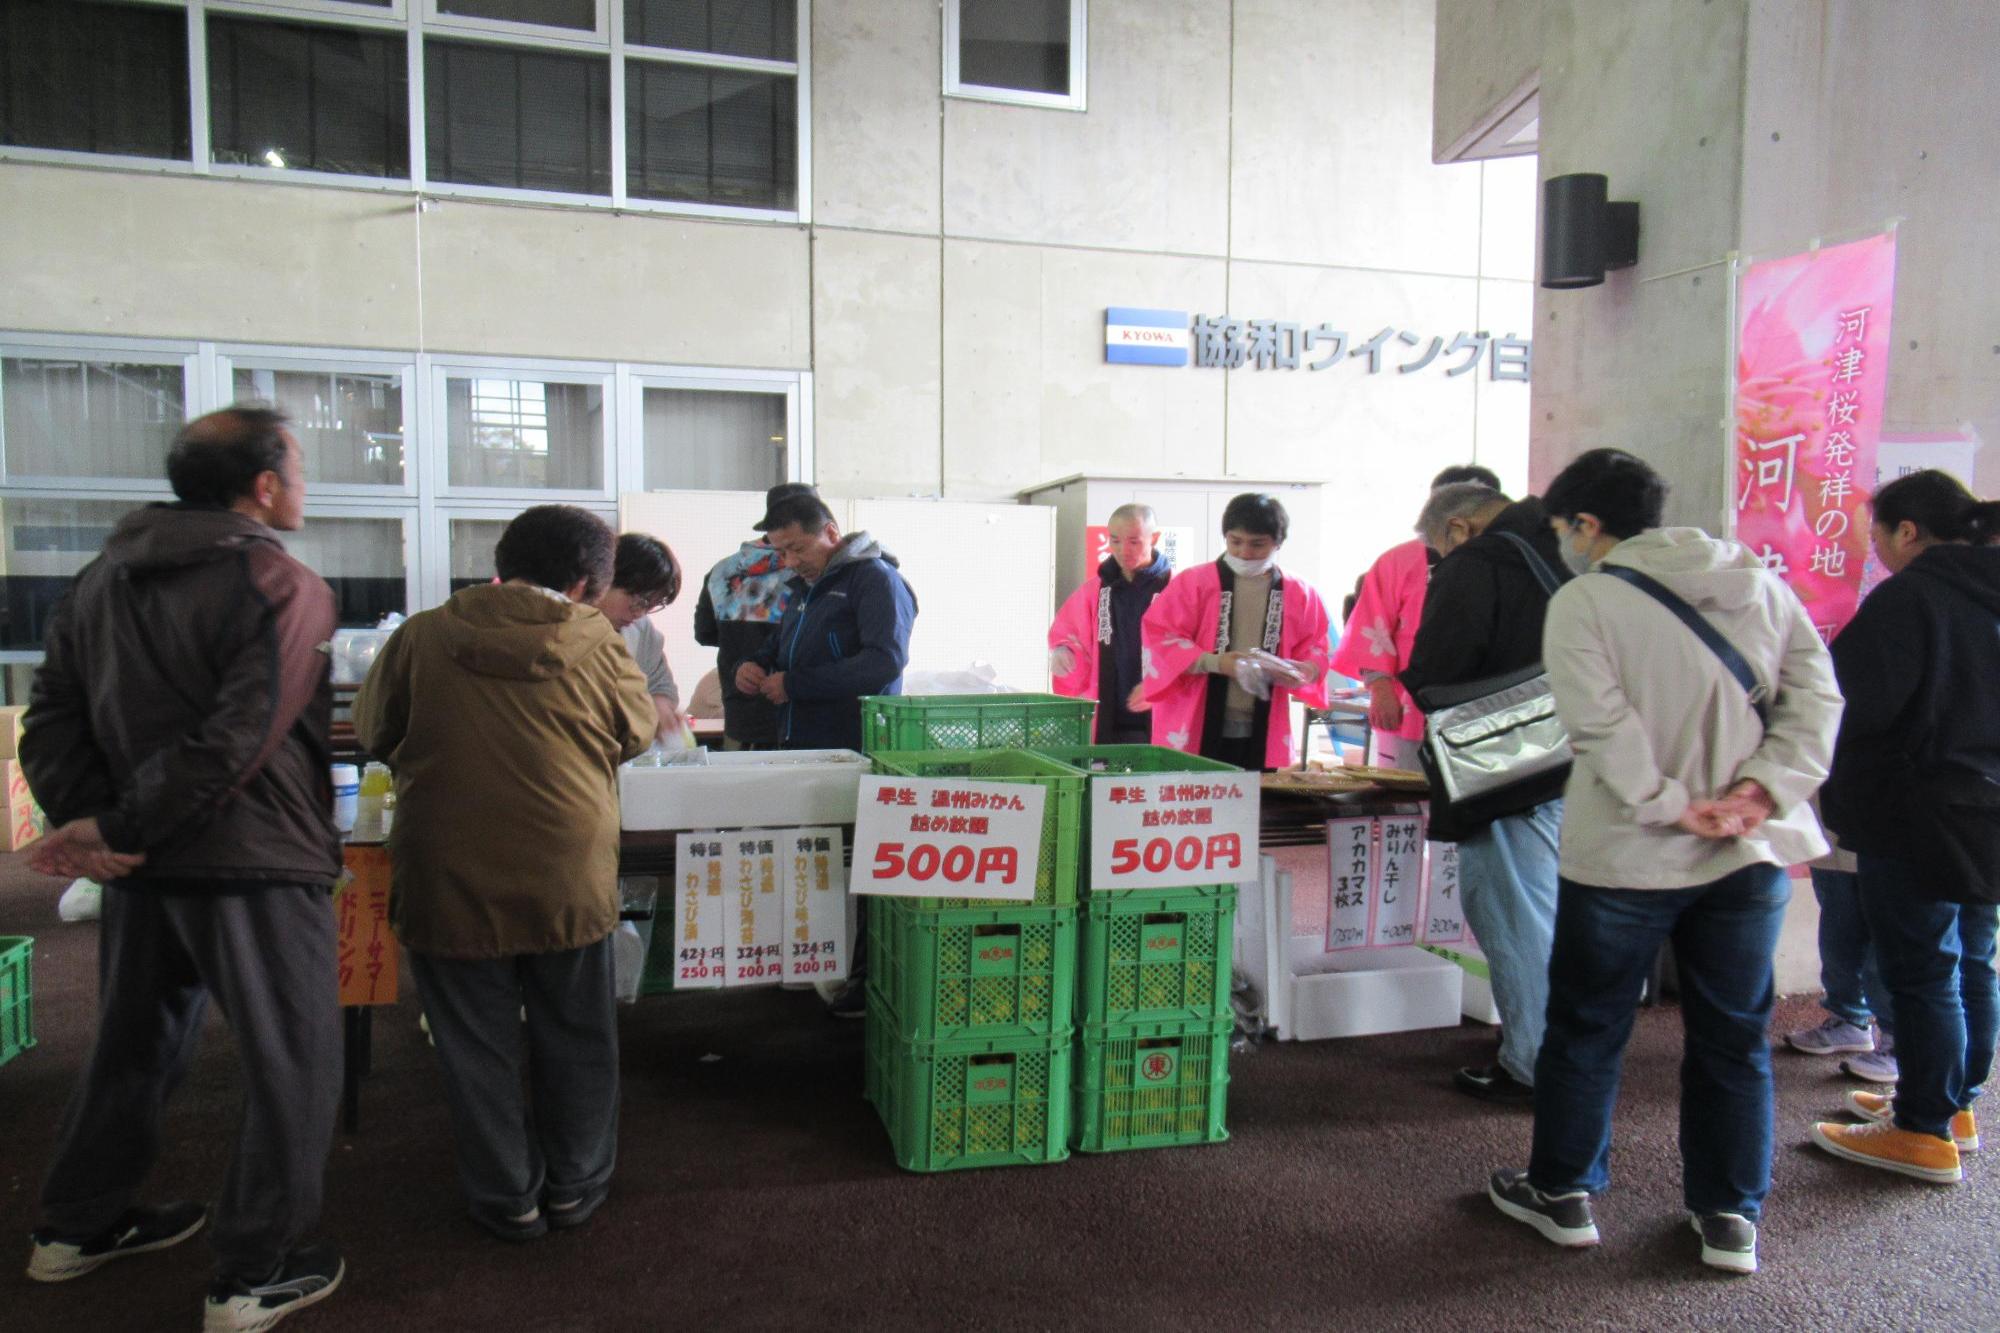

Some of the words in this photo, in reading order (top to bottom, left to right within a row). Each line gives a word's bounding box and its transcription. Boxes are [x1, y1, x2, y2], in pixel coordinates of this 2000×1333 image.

[1122, 329, 1174, 343] KYOWA
[1808, 306, 1872, 578] 河津桜発祥の地
[876, 787, 917, 807] 早生
[931, 789, 1025, 811] 温州みかん
[1109, 786, 1146, 804] 早生
[1159, 784, 1243, 803] 温州みかん
[910, 814, 989, 835] 詰め放題
[1142, 807, 1213, 827] 詰め放題
[1403, 824, 1417, 853] サバ
[872, 842, 1018, 884] 500円
[1111, 832, 1241, 874] 500円
[1383, 824, 1400, 904] みりん干し
[1351, 825, 1366, 906] アカカマス
[681, 966, 724, 979] 250円
[738, 963, 781, 978] 200円
[793, 960, 836, 974] 200円
